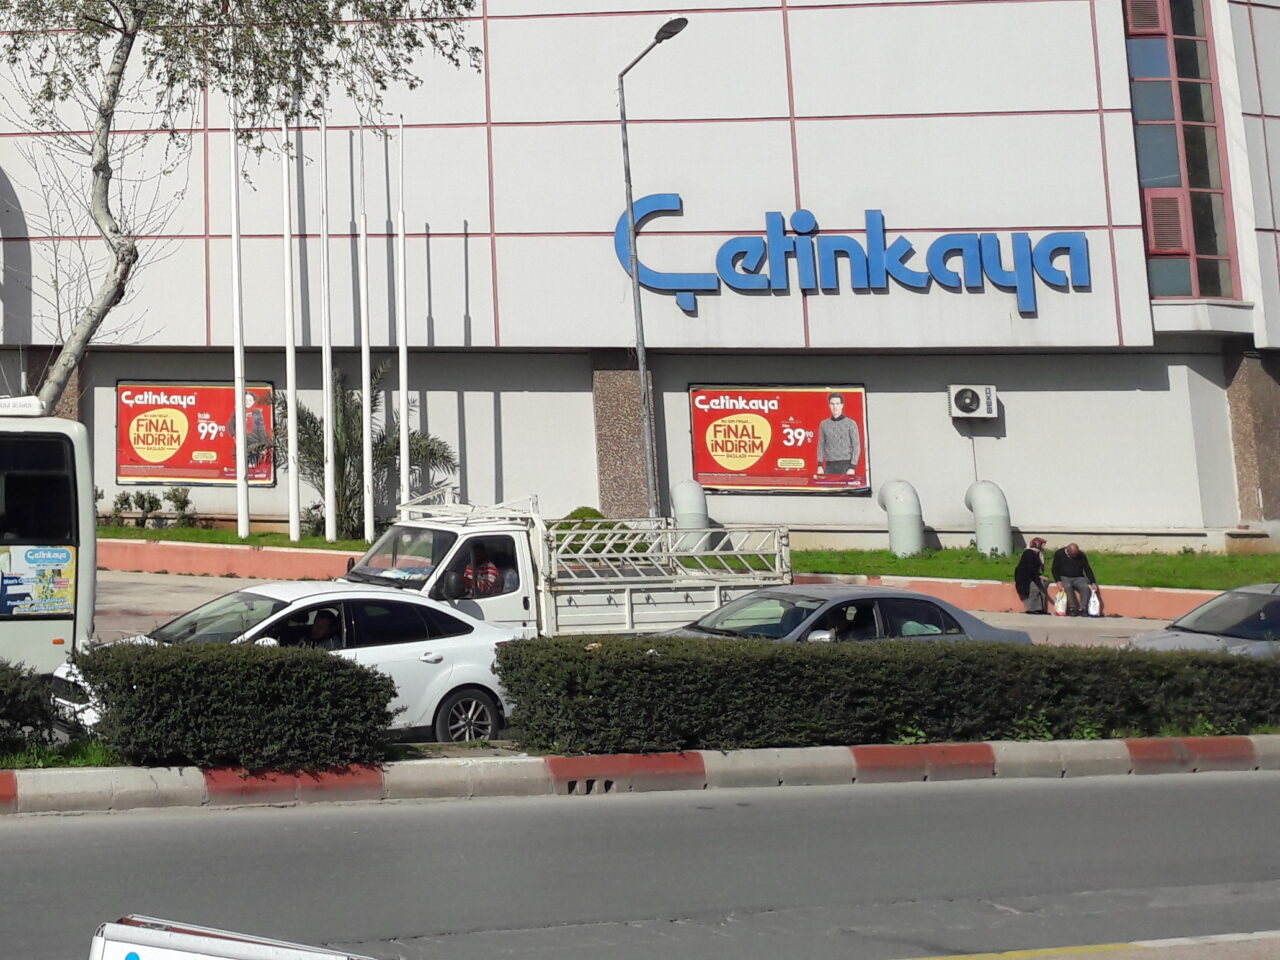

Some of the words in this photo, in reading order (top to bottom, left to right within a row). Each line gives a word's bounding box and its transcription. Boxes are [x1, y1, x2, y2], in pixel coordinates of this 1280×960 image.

[614, 193, 1091, 316] Çetinkaya
[121, 391, 195, 408] Çetinkaya
[695, 396, 779, 413] Çetinkaya
